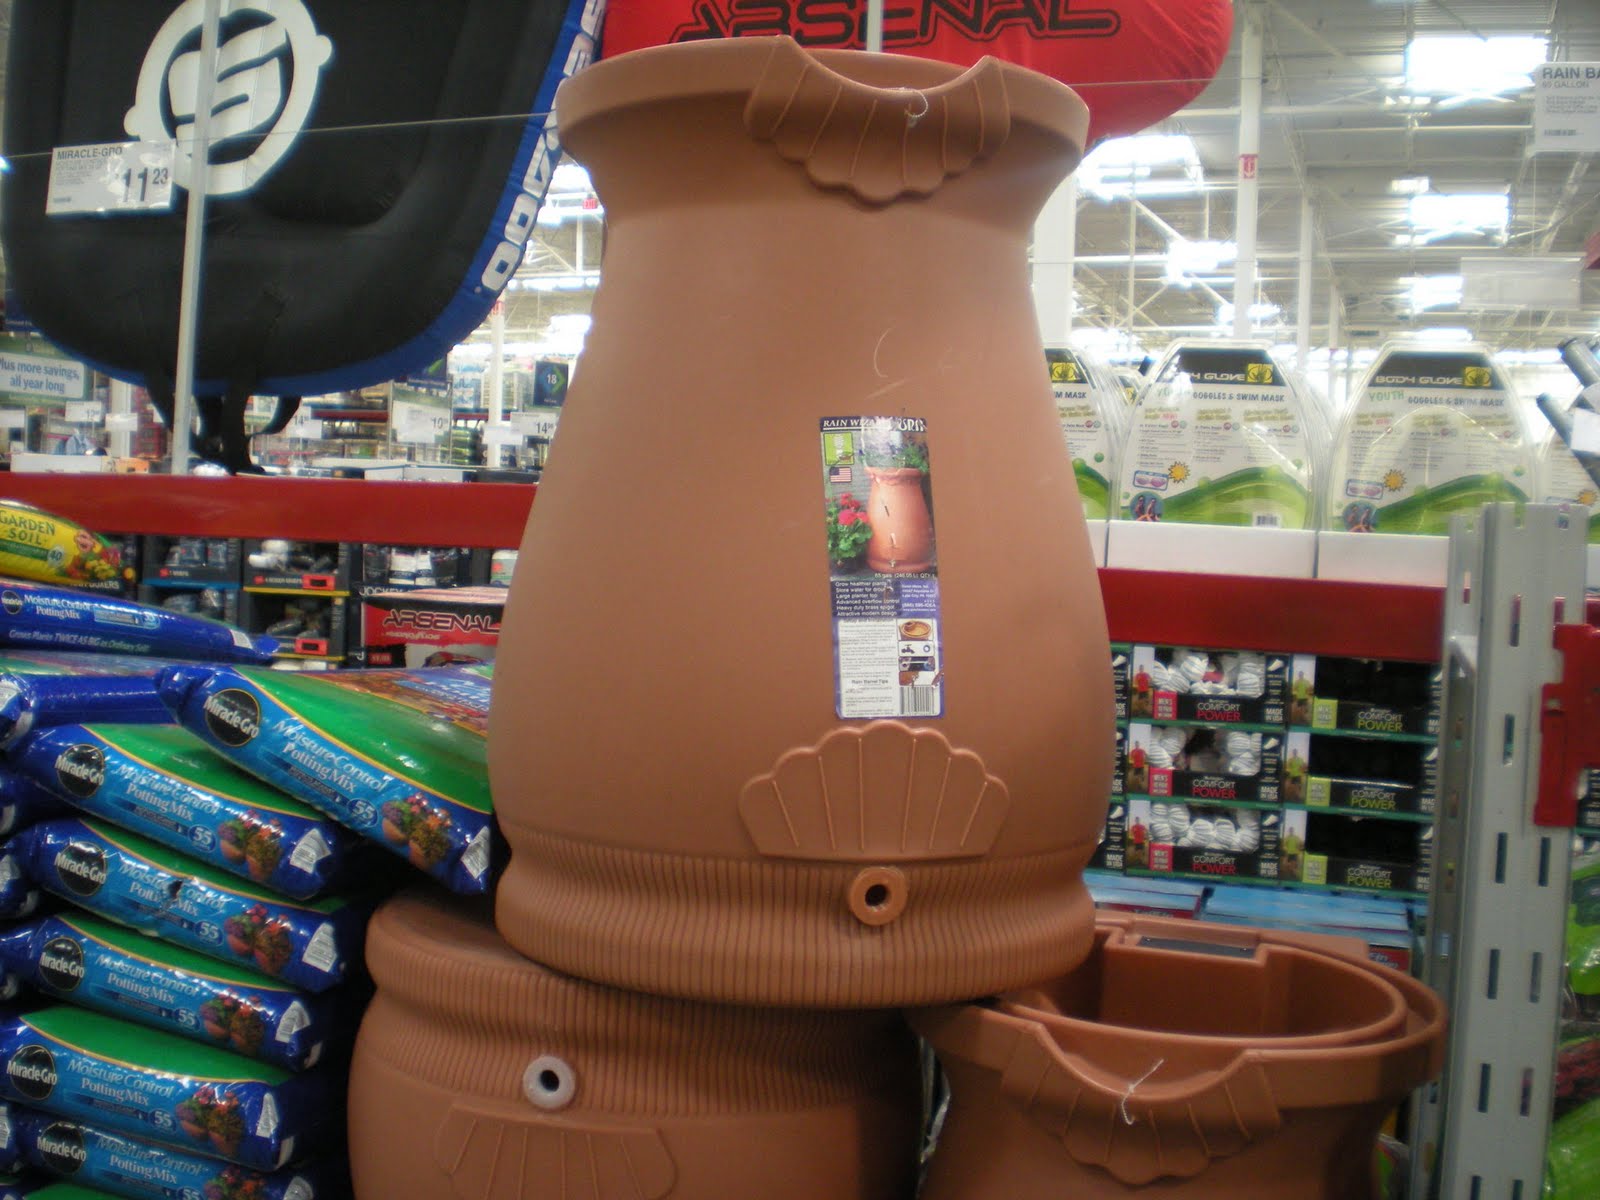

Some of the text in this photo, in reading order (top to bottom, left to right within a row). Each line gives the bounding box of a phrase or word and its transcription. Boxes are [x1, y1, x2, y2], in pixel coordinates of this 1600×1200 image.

[1542, 66, 1580, 80] RAIN
[0, 357, 16, 371] lus
[17, 362, 42, 375] more
[10, 375, 66, 395] all year long
[546, 373, 558, 385] 18
[1203, 372, 1246, 381] GLOVE
[1375, 375, 1463, 386] BODY GLOVE
[1064, 391, 1088, 400] MASK
[1235, 392, 1260, 402] SWIM
[1260, 393, 1286, 403] MASK
[1368, 389, 1406, 402] YOUTH
[823, 418, 847, 428] RAIN
[0, 509, 56, 537] GARDEN
[8, 527, 42, 546] SOIL
[64, 608, 81, 620] Mix
[383, 608, 499, 635] ARSENAL
[1196, 703, 1241, 713] COMFORT
[1196, 711, 1241, 722] POWER
[1357, 710, 1404, 721] COMFORT
[1357, 719, 1403, 732] POWER
[282, 742, 357, 794] Potting Mix
[333, 754, 390, 792] Control
[1191, 787, 1237, 799] POWER
[1192, 780, 1236, 790] COMFORT
[126, 782, 194, 821] Potting Mix
[352, 800, 376, 820] 55
[1351, 797, 1397, 810] POWER
[192, 826, 212, 845] 55
[1191, 863, 1237, 875] POWER
[1346, 875, 1392, 889] POWER
[175, 899, 199, 917] Mix
[199, 922, 219, 939] 55
[107, 972, 176, 1005] Potting Mix
[178, 1009, 196, 1026] 55
[67, 1058, 175, 1098] Moisture Control
[81, 1077, 150, 1106] Potting Mix
[154, 1110, 173, 1127] 55
[97, 1136, 202, 1176] Moisture Control
[109, 1155, 178, 1184] Potting Mix
